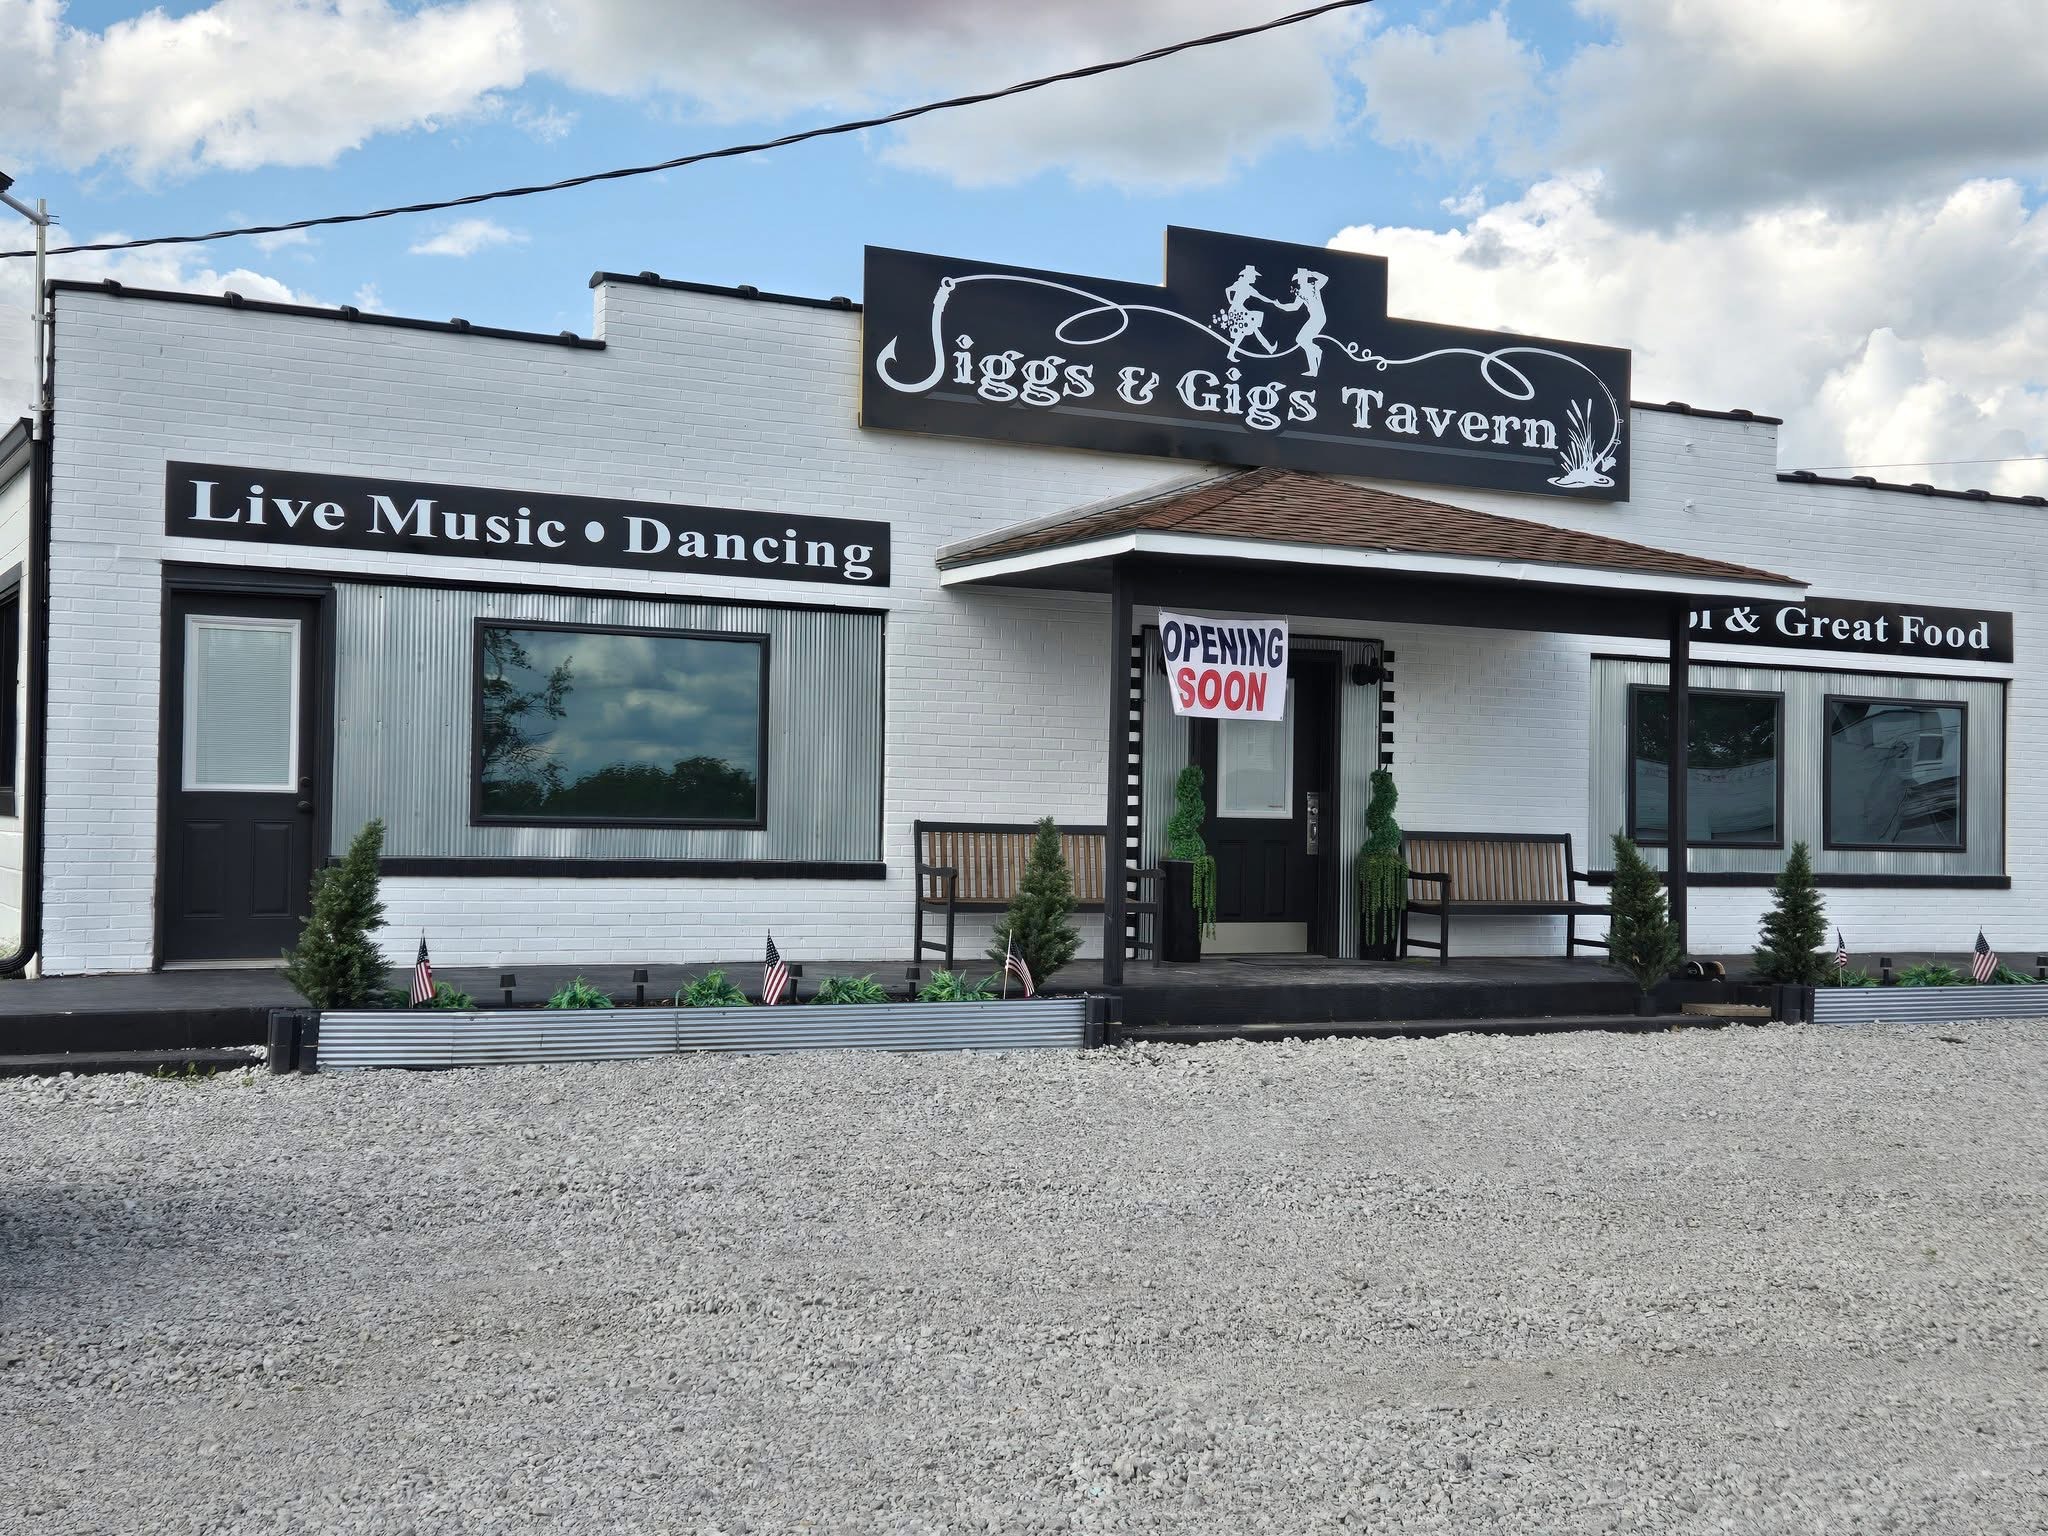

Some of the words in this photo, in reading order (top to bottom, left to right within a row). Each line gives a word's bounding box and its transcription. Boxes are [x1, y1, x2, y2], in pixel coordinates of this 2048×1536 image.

[1117, 366, 1159, 405] &
[1176, 367, 1316, 430] Gigs
[1342, 385, 1559, 449] Tavern
[188, 480, 346, 531] Live
[366, 494, 566, 548] Music
[622, 515, 874, 581] Dancing
[1162, 620, 1283, 668] OPENING
[1725, 606, 1760, 633] &
[1775, 606, 1889, 643] Great
[1899, 614, 1990, 650] Food
[1176, 667, 1268, 712] SOON
